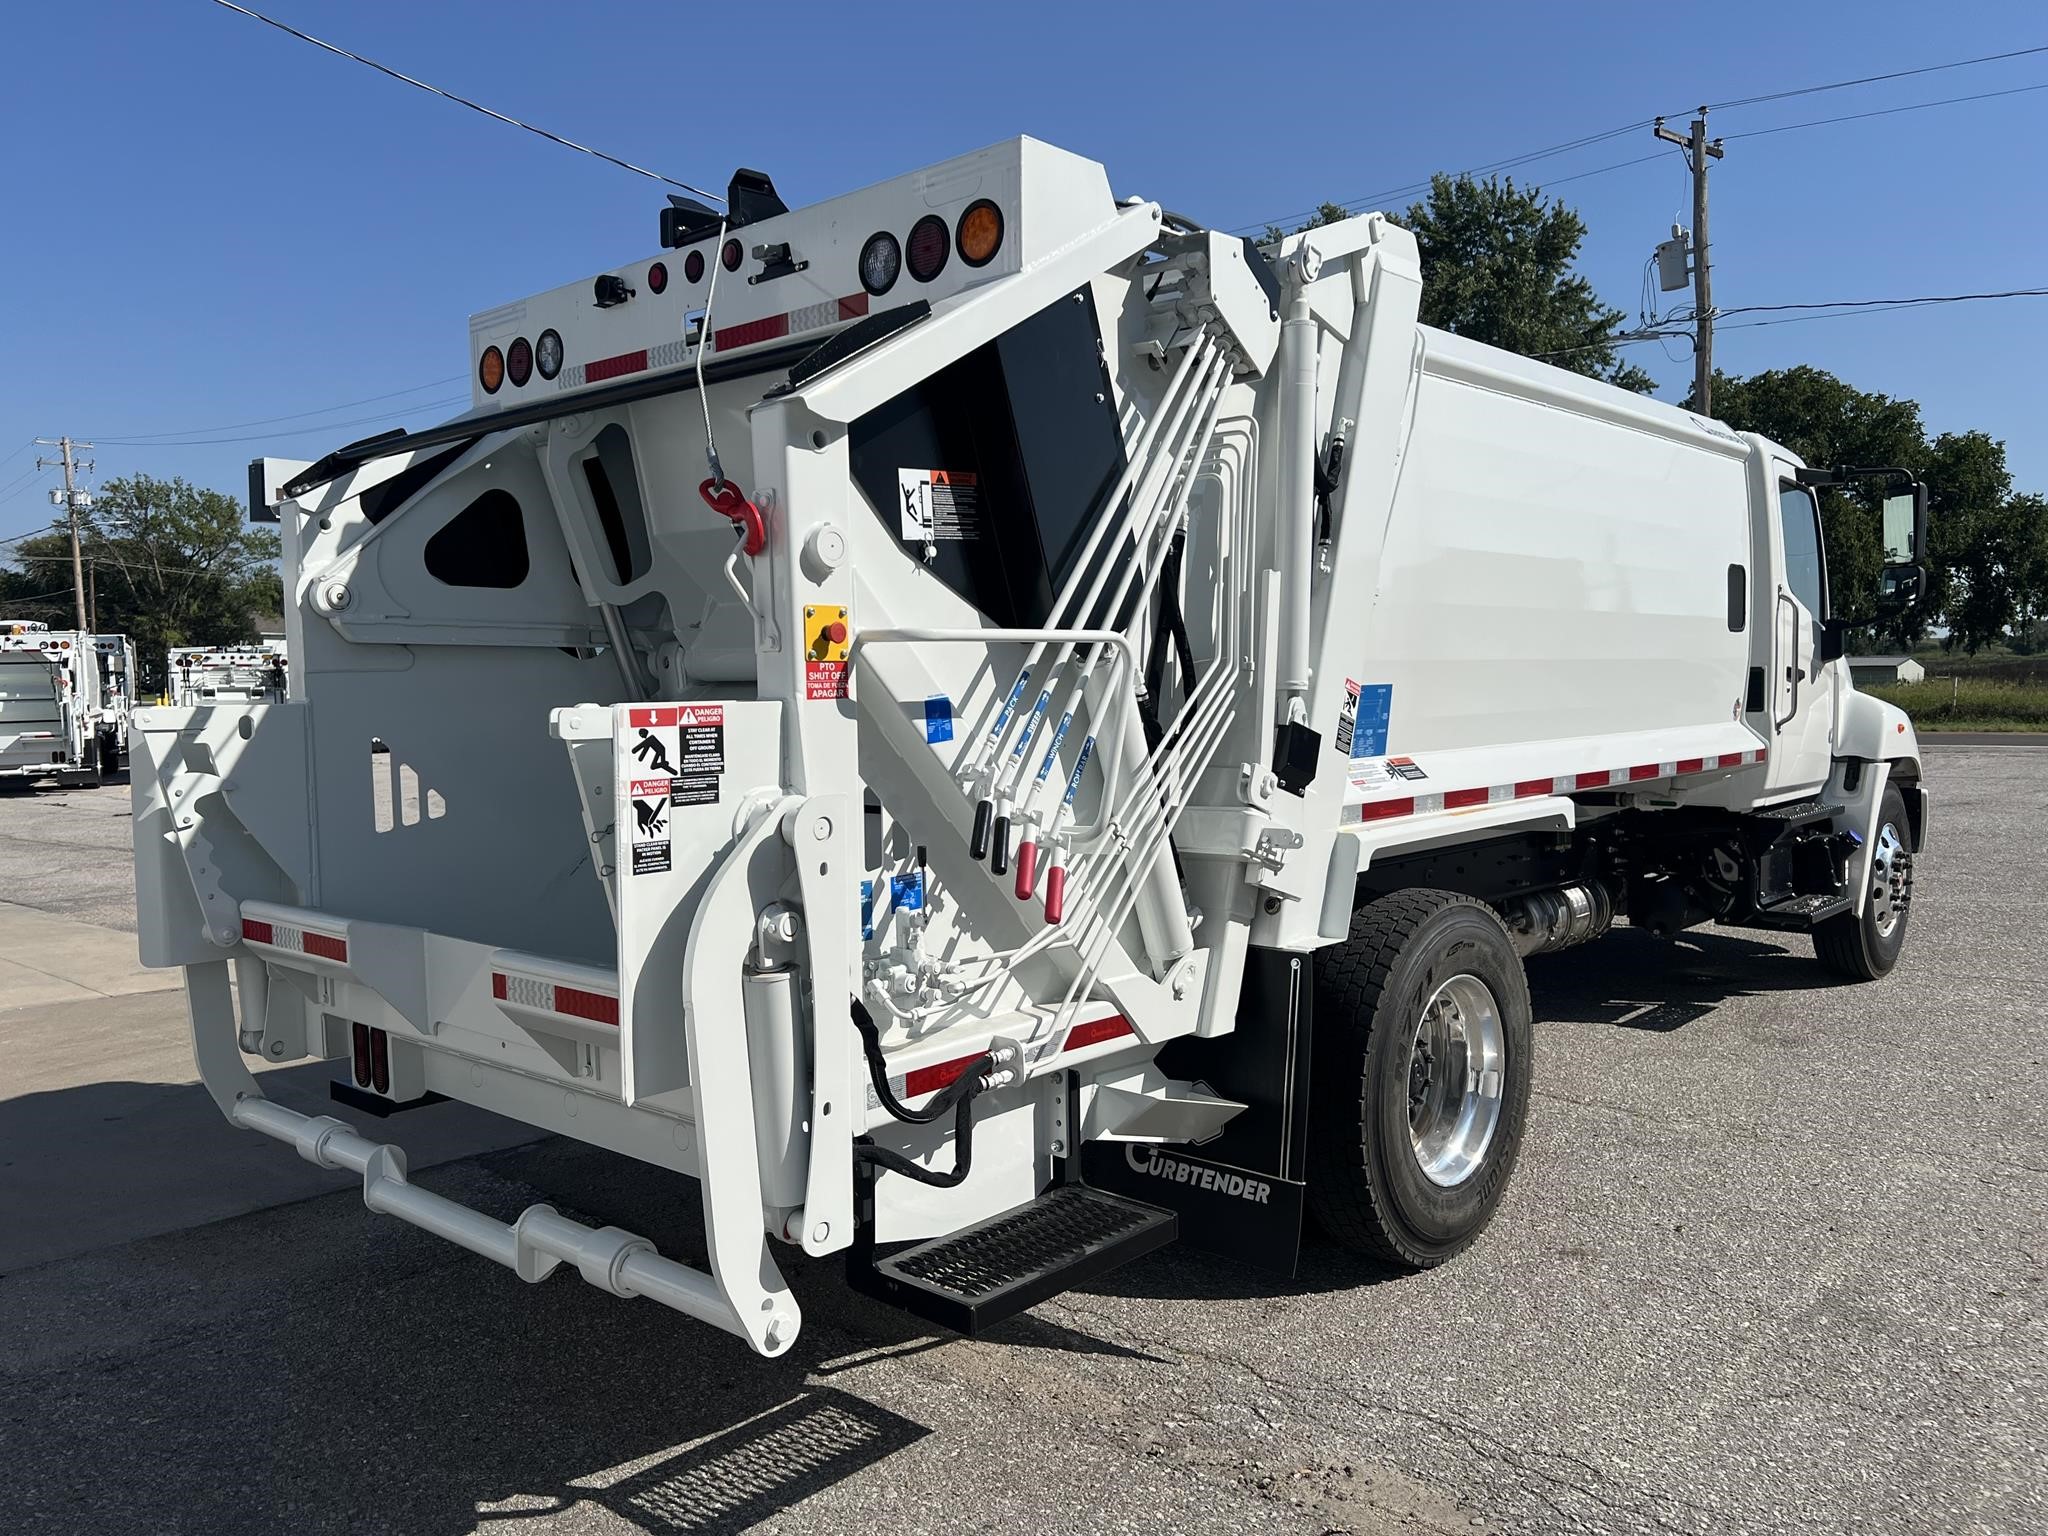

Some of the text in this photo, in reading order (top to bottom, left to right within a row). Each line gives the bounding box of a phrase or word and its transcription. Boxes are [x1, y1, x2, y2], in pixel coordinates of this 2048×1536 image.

[819, 662, 835, 671] PTO
[808, 671, 846, 680] SHUT OFF
[811, 689, 844, 698] APAGAR
[1004, 694, 1019, 716] PACK
[695, 708, 723, 716] DANGER
[1026, 710, 1041, 734] SWEEP
[1047, 733, 1064, 759] WINCH
[643, 780, 669, 788] DANGER
[1125, 1142, 1271, 1205] CURBTENDER
